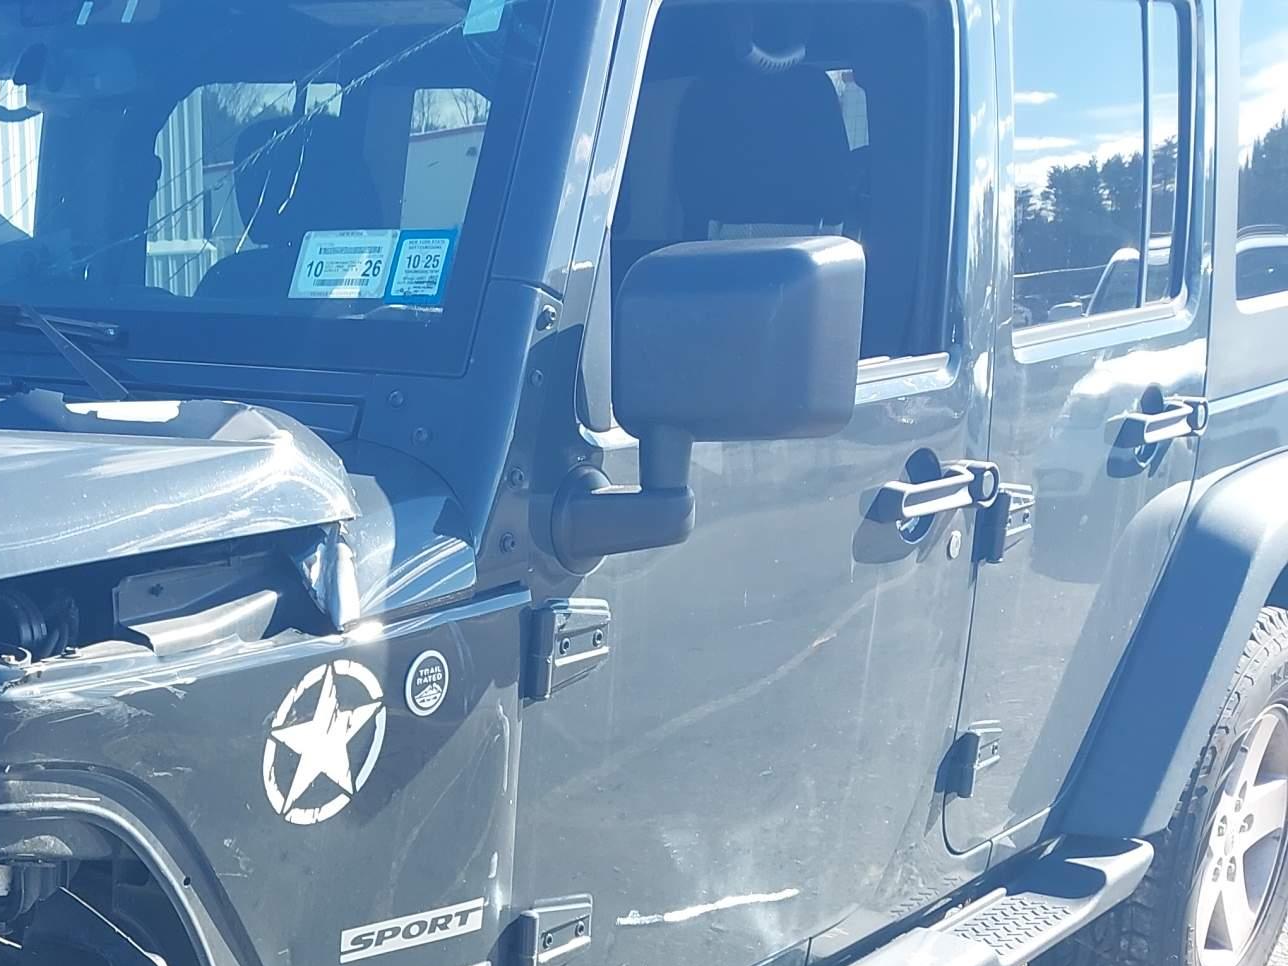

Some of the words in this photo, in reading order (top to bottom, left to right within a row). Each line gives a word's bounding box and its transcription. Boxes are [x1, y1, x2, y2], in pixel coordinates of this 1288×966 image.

[306, 260, 324, 278] 10
[361, 259, 383, 278] 26
[406, 254, 421, 269] 10
[424, 254, 441, 269] 25
[418, 665, 442, 677] TRAIL
[416, 672, 443, 686] RATED
[343, 906, 482, 954] SPORT
